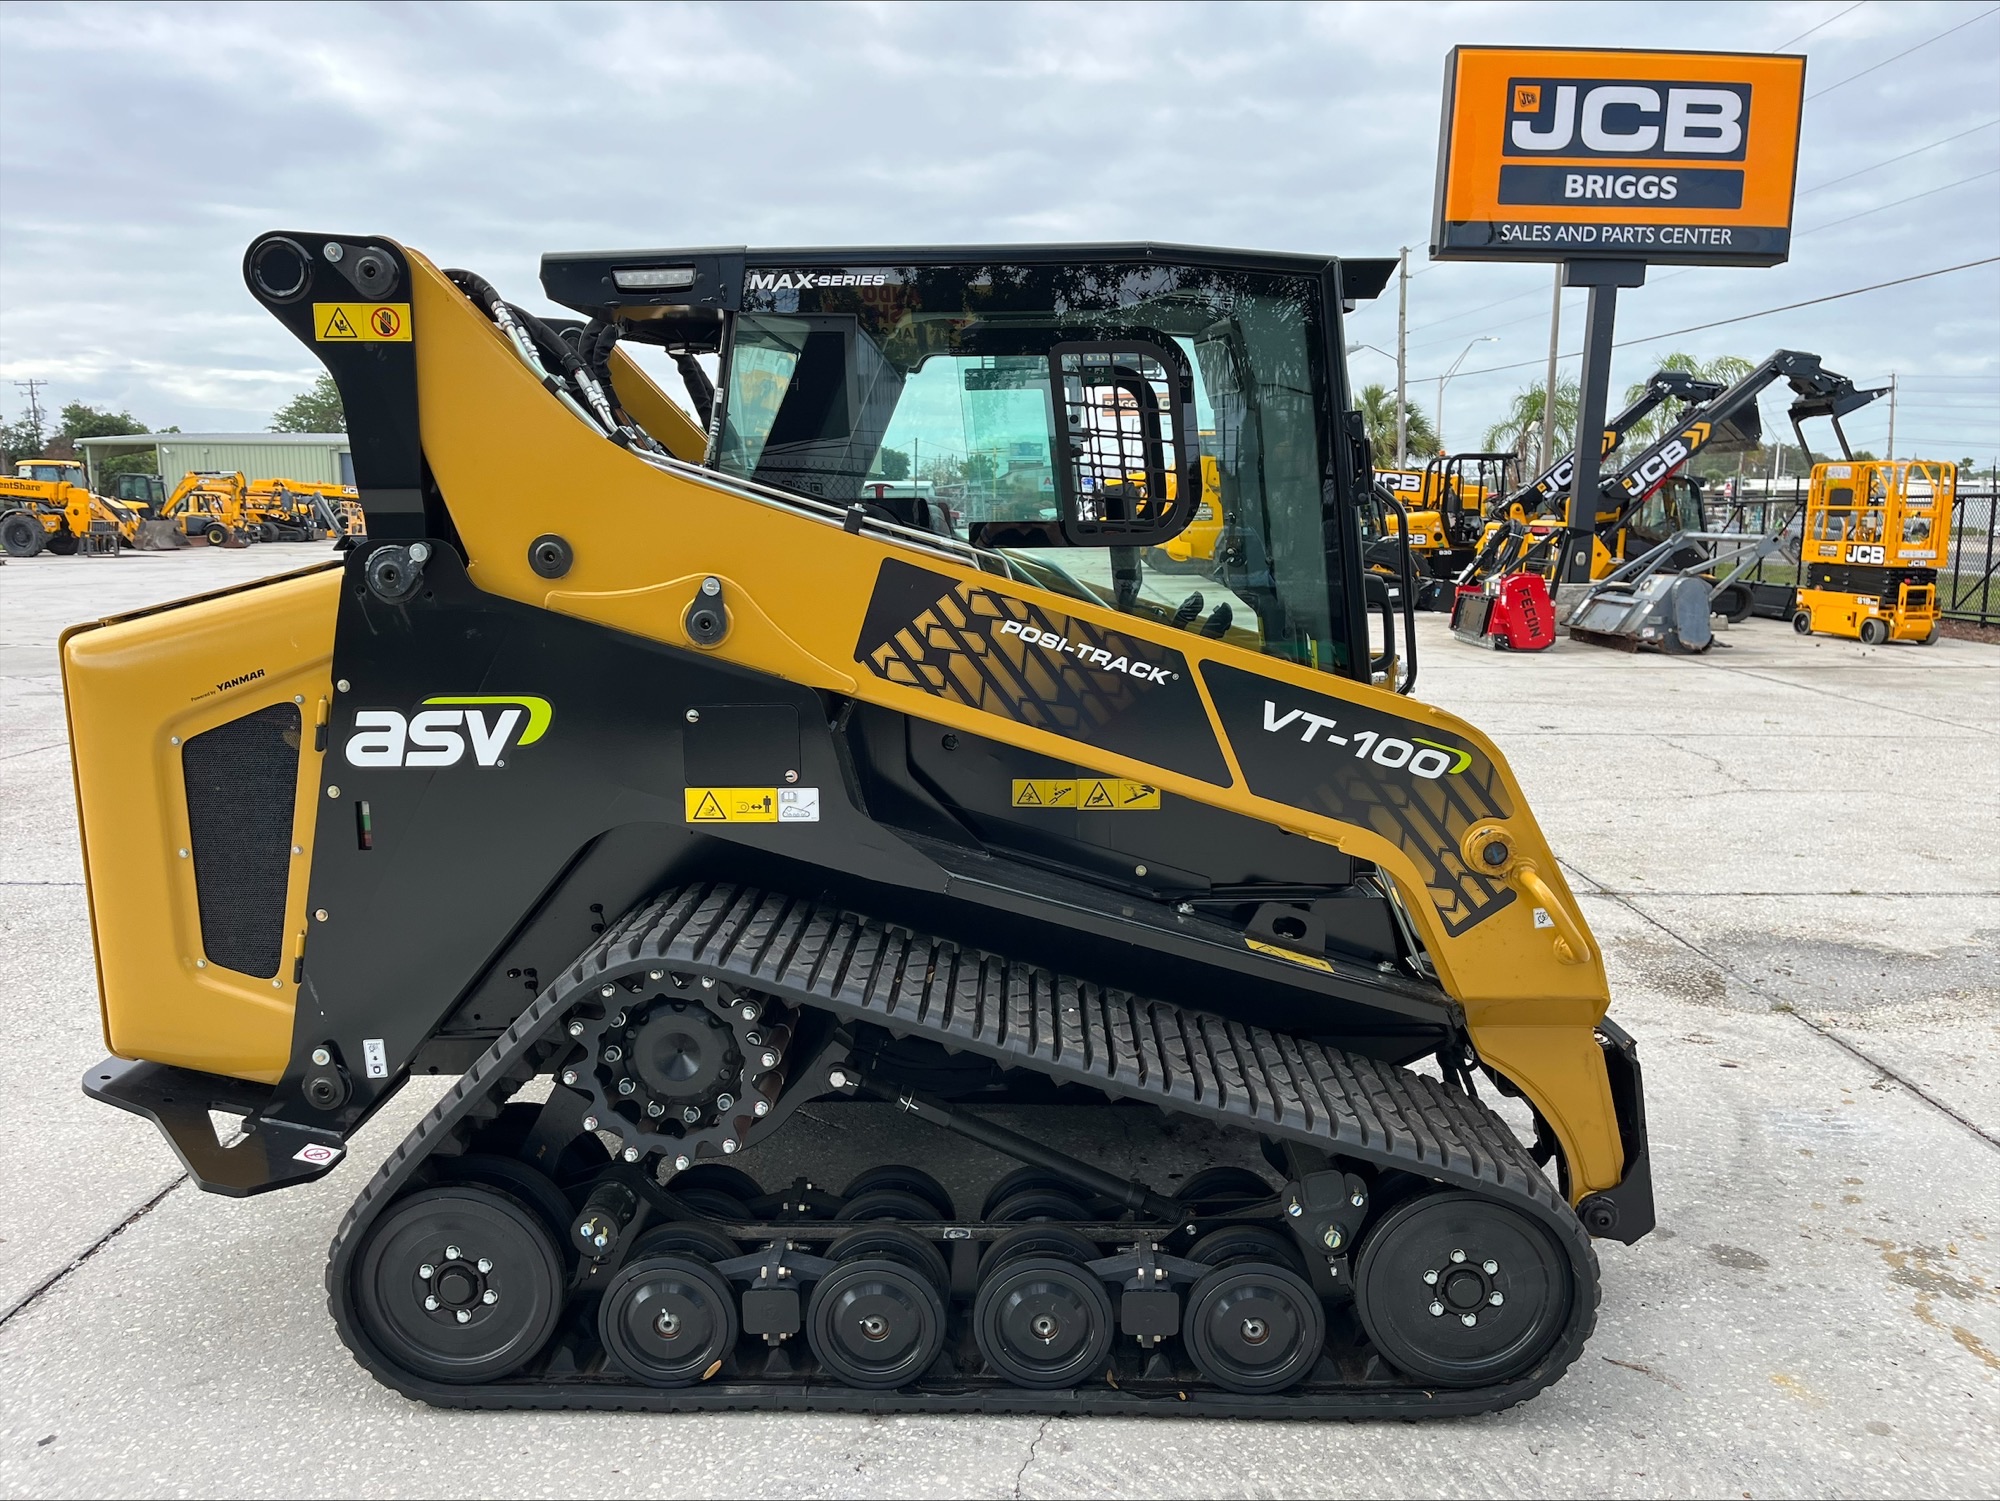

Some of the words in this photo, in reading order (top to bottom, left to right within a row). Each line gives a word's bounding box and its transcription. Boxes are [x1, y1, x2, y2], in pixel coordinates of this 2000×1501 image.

[1511, 85, 1743, 154] JCB
[1564, 174, 1678, 200] BRIGGS
[1501, 224, 1551, 242] SALES
[1555, 225, 1597, 243] AND
[1602, 226, 1655, 244] PARTS
[1660, 227, 1732, 246] CENTER
[1105, 399, 1138, 408] BIGG
[1542, 457, 1574, 498] JC
[1626, 439, 1688, 496] JCB
[342, 487, 358, 495] JC
[1408, 534, 1426, 545] CB
[1846, 546, 1884, 564] JCB
[1518, 588, 1541, 638] FECON
[191, 691, 210, 702] Powered
[216, 669, 265, 692] YANMAR
[1263, 700, 1451, 779] VT-100
